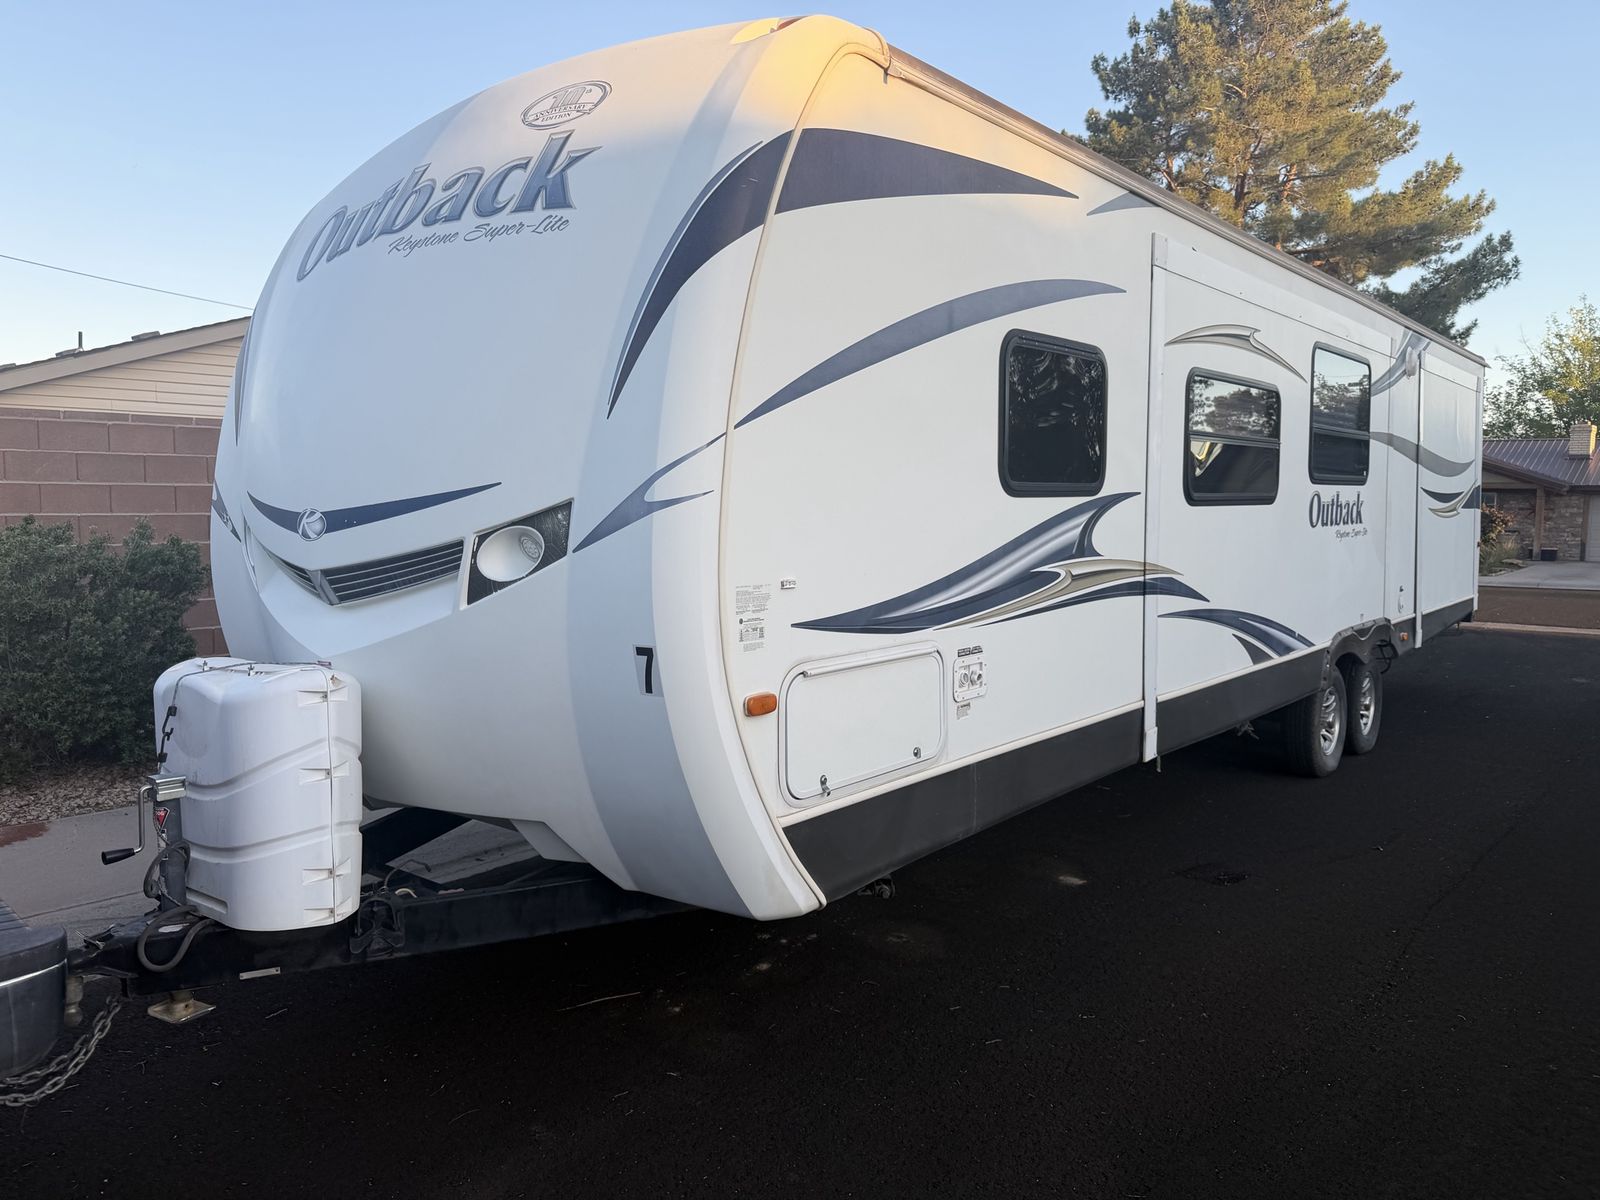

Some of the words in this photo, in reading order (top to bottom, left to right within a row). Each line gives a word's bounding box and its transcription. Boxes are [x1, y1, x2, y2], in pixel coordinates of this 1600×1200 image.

[541, 112, 571, 122] EDITION
[296, 129, 602, 282] Outback
[388, 231, 459, 257] Keystone
[463, 214, 570, 242] Super-Lite
[1309, 490, 1364, 528] Outback
[635, 646, 654, 694] 7
